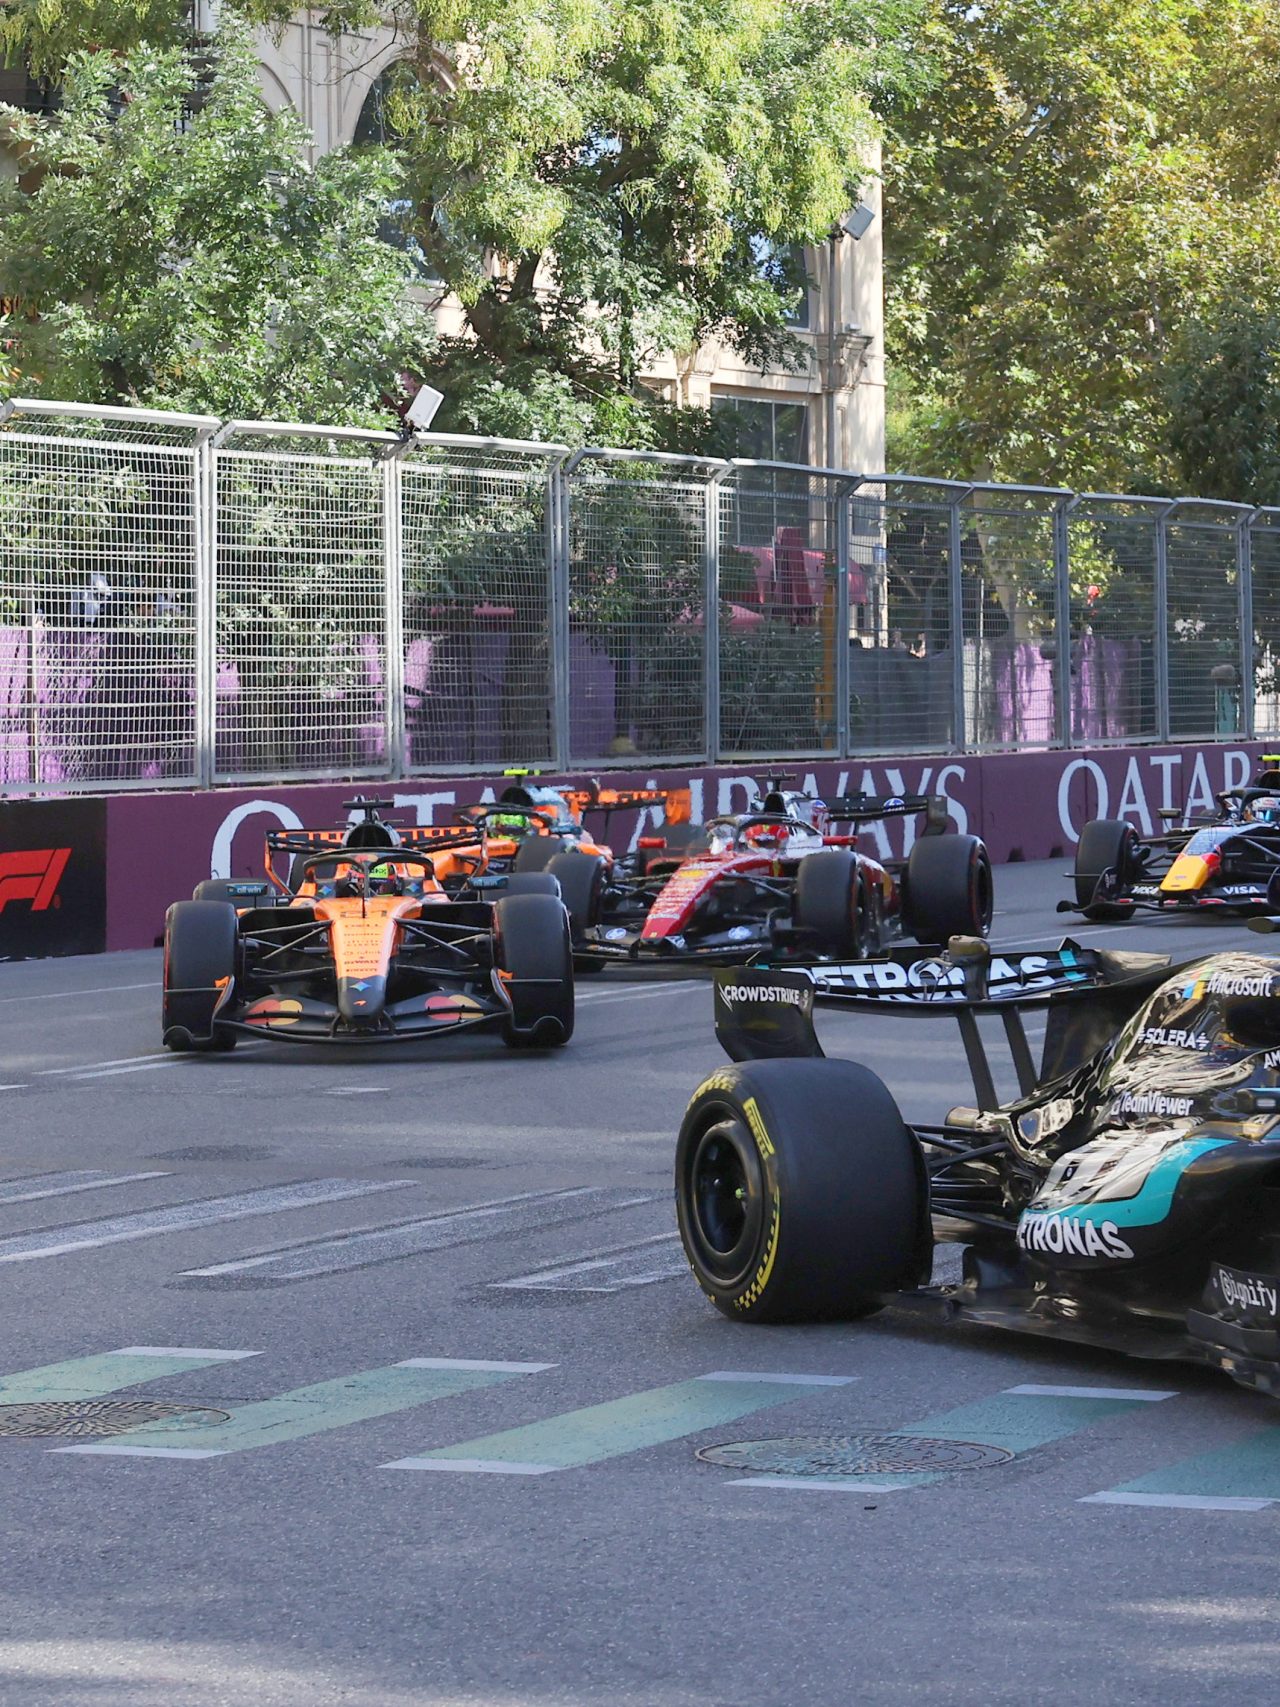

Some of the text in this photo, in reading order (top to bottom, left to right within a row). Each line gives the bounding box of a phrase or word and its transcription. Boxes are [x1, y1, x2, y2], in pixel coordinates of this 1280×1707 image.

[1222, 885, 1260, 894] VISA
[723, 984, 799, 1005] CROWDSTRIKE
[1207, 972, 1273, 997] Microsoft
[1146, 1027, 1197, 1049] SOLERA
[1120, 1091, 1194, 1115] TeamViewer
